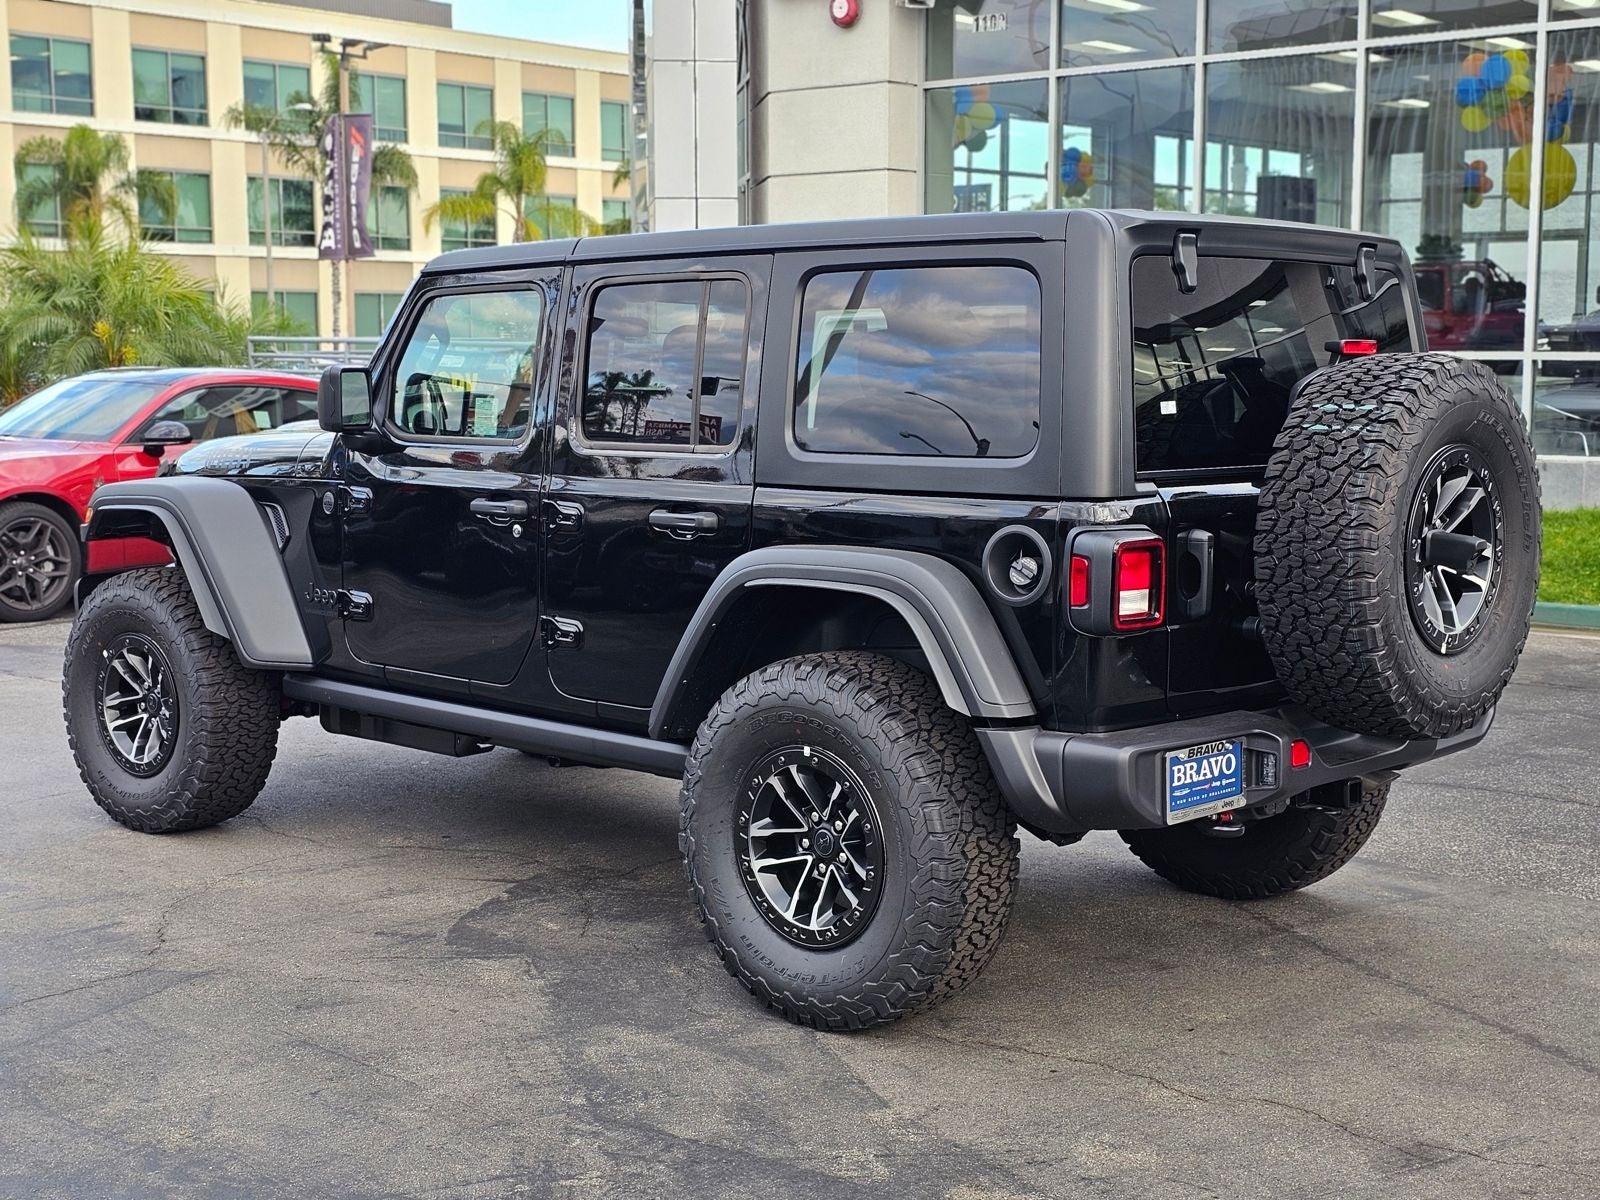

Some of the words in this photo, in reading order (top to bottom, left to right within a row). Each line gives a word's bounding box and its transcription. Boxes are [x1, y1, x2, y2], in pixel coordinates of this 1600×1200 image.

[304, 582, 338, 605] Jeep
[748, 710, 883, 790] BFGoodrich
[1187, 741, 1225, 758] BRAVO
[1172, 753, 1236, 787] BRAVO
[1221, 799, 1235, 809] Jeep
[737, 934, 867, 987] All-Terrain
